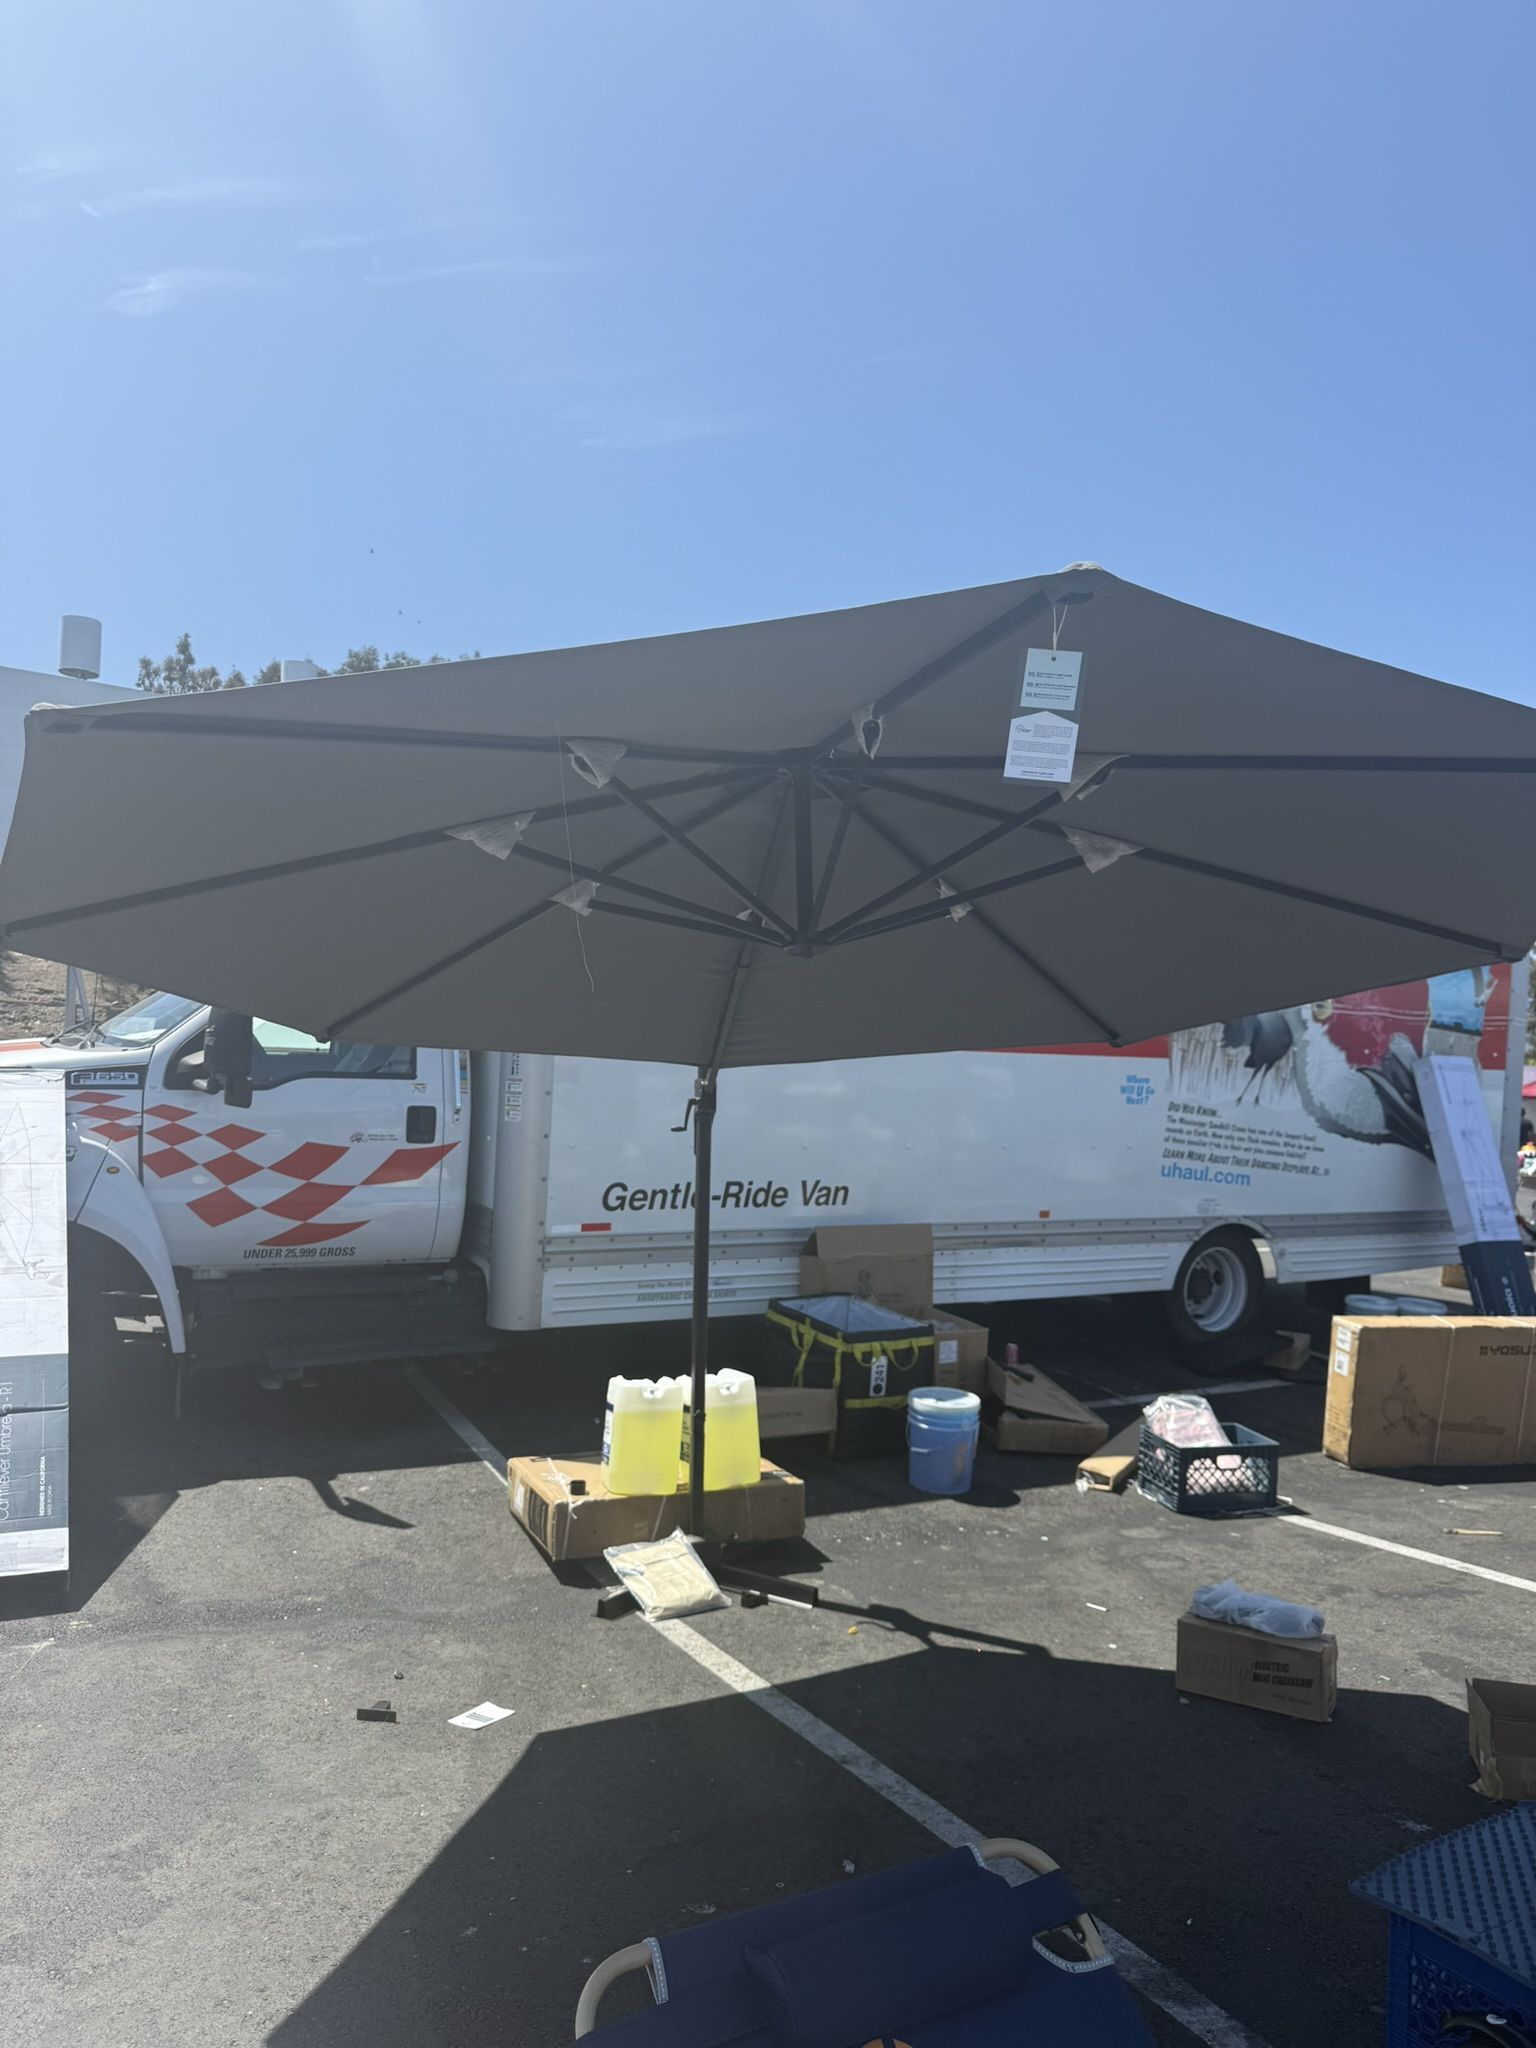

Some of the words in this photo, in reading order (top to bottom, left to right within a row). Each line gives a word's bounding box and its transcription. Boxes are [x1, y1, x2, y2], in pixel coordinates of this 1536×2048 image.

[1161, 1162, 1250, 1186] uhaul.com
[602, 1180, 788, 1211] Gentl-Ride
[800, 1180, 849, 1206] Van
[243, 1248, 281, 1259] UNDER
[284, 1248, 317, 1259] 25,999
[319, 1246, 356, 1257] GROSS
